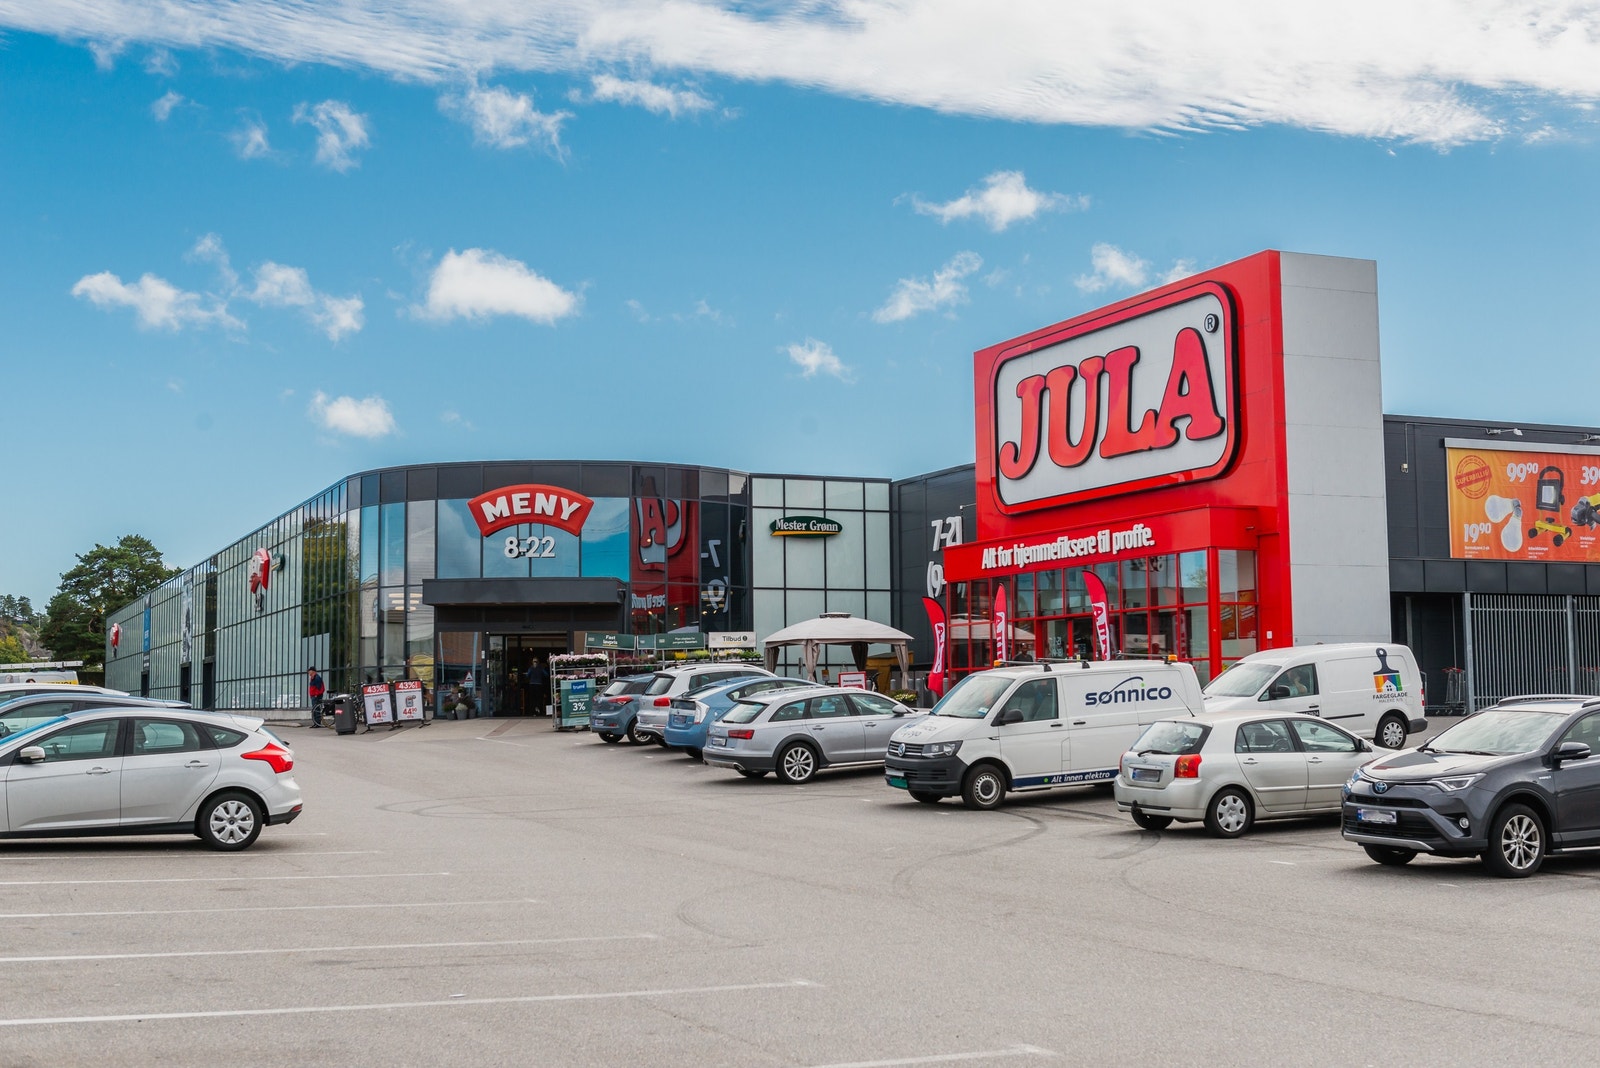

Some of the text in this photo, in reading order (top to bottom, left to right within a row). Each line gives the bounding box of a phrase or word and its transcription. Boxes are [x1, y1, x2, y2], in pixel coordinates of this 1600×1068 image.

[1000, 327, 1226, 480] JULA
[480, 492, 582, 523] MENY
[775, 518, 839, 532] Mester Grønn
[931, 515, 963, 552] 7-21
[504, 535, 556, 558] 8-22
[981, 523, 1155, 569] Alt for hjemmefiksere til proffe.
[572, 702, 586, 711] 3%
[1050, 771, 1110, 783] Alt innen elektro
